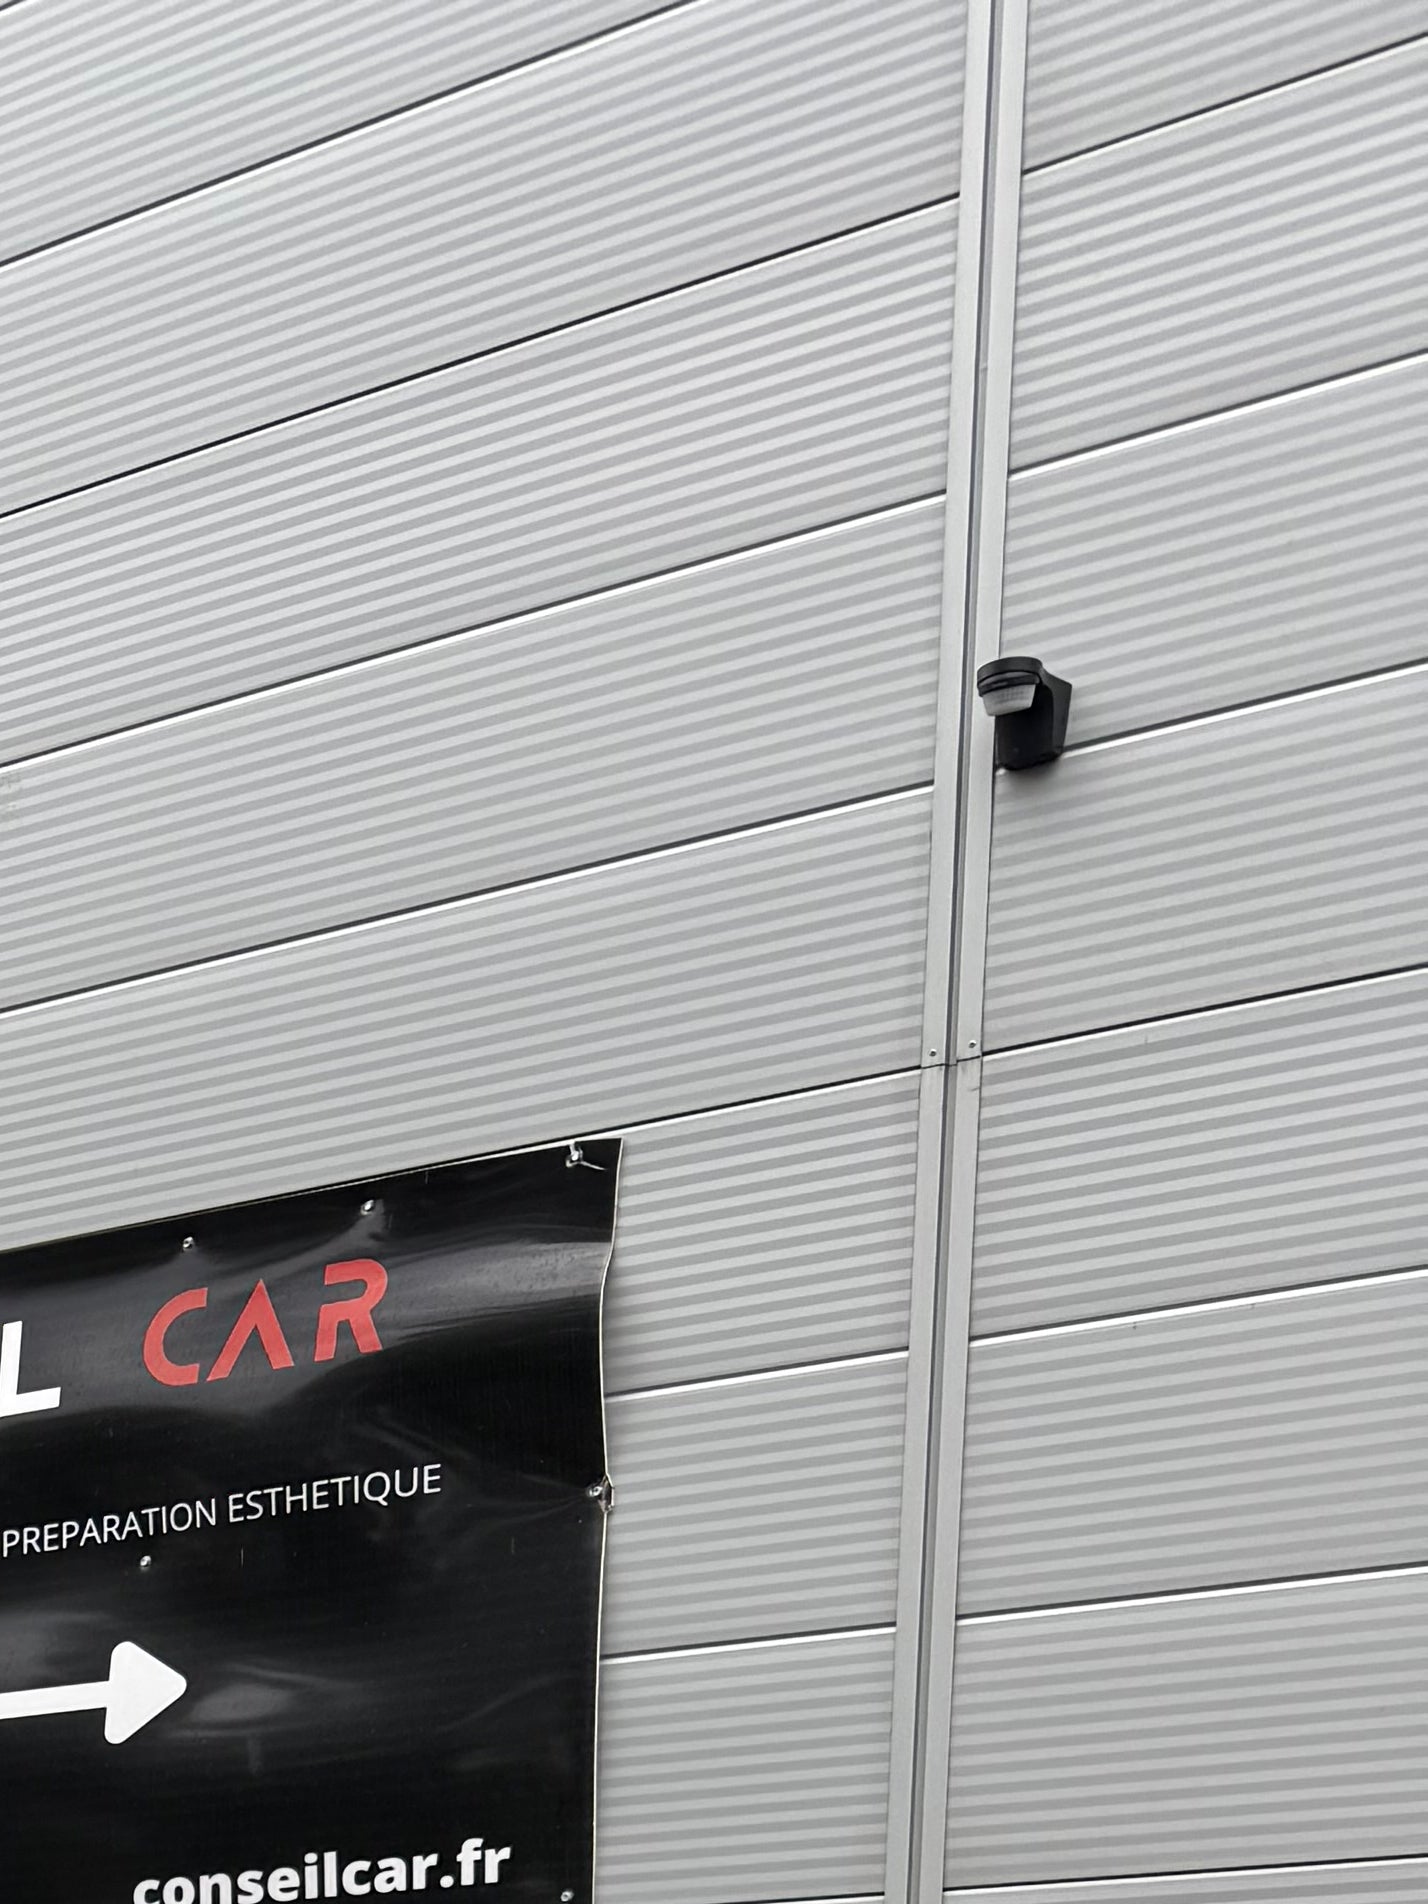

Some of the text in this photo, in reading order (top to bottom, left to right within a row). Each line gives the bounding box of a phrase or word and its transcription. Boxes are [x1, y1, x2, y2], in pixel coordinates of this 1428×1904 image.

[143, 1259, 389, 1386] CAR
[1, 1498, 217, 1558] PREPARATION
[228, 1463, 442, 1523] ESTHETIQUE
